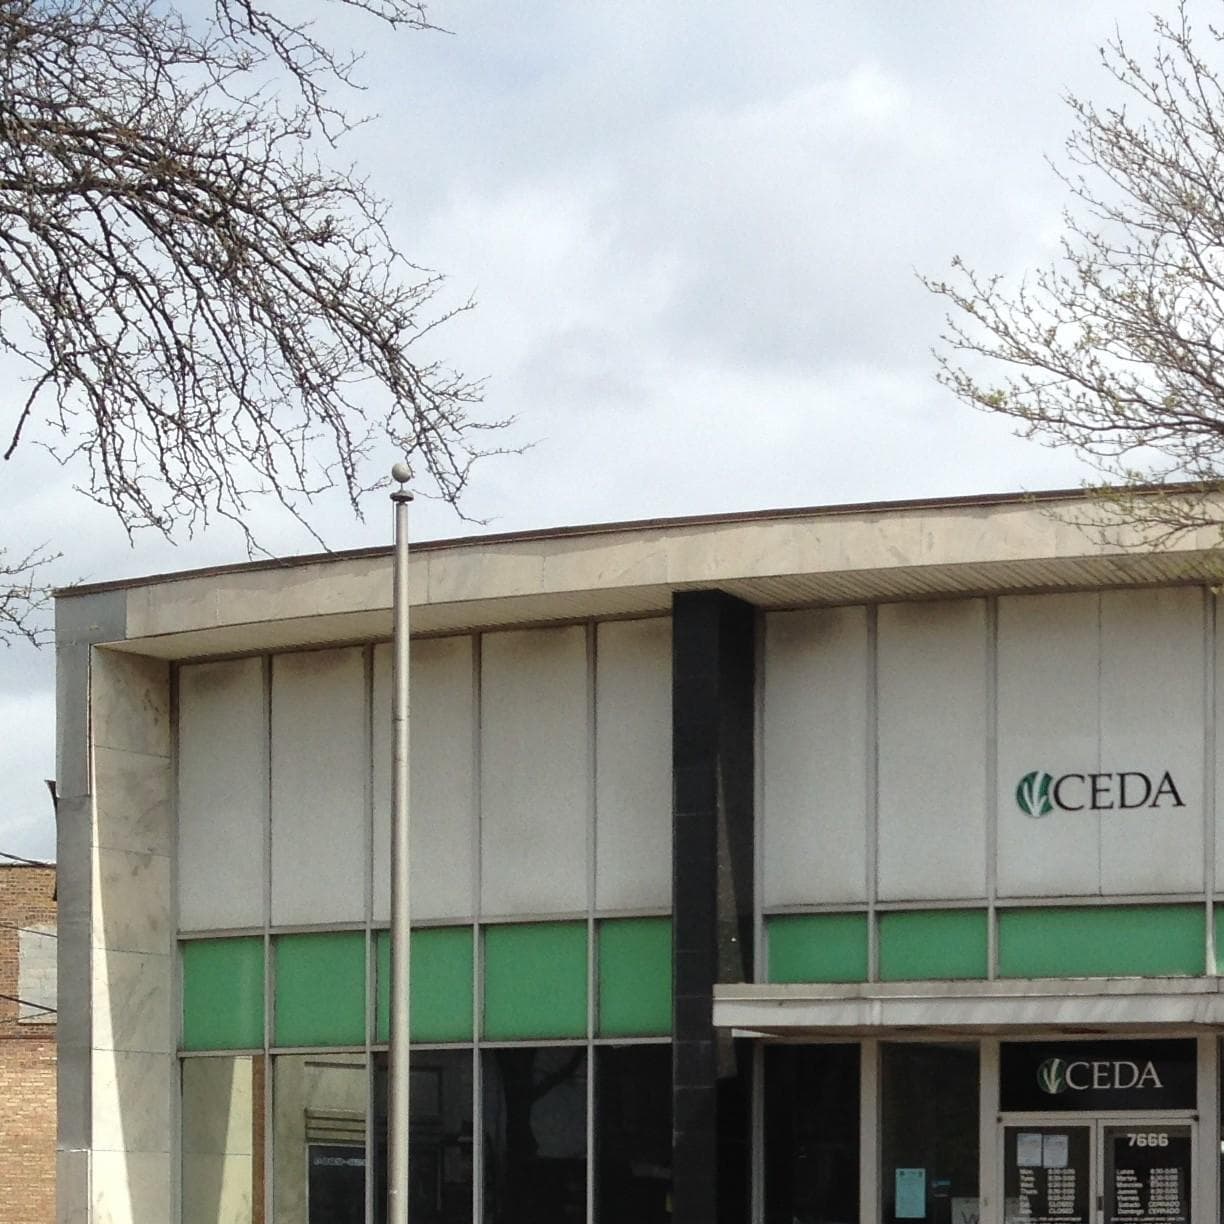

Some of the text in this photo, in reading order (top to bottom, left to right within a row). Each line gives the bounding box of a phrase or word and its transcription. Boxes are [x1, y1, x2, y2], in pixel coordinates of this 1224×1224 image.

[1053, 770, 1186, 811] CEDA
[1065, 1057, 1164, 1091] CEDA
[1127, 1133, 1169, 1147] 7666
